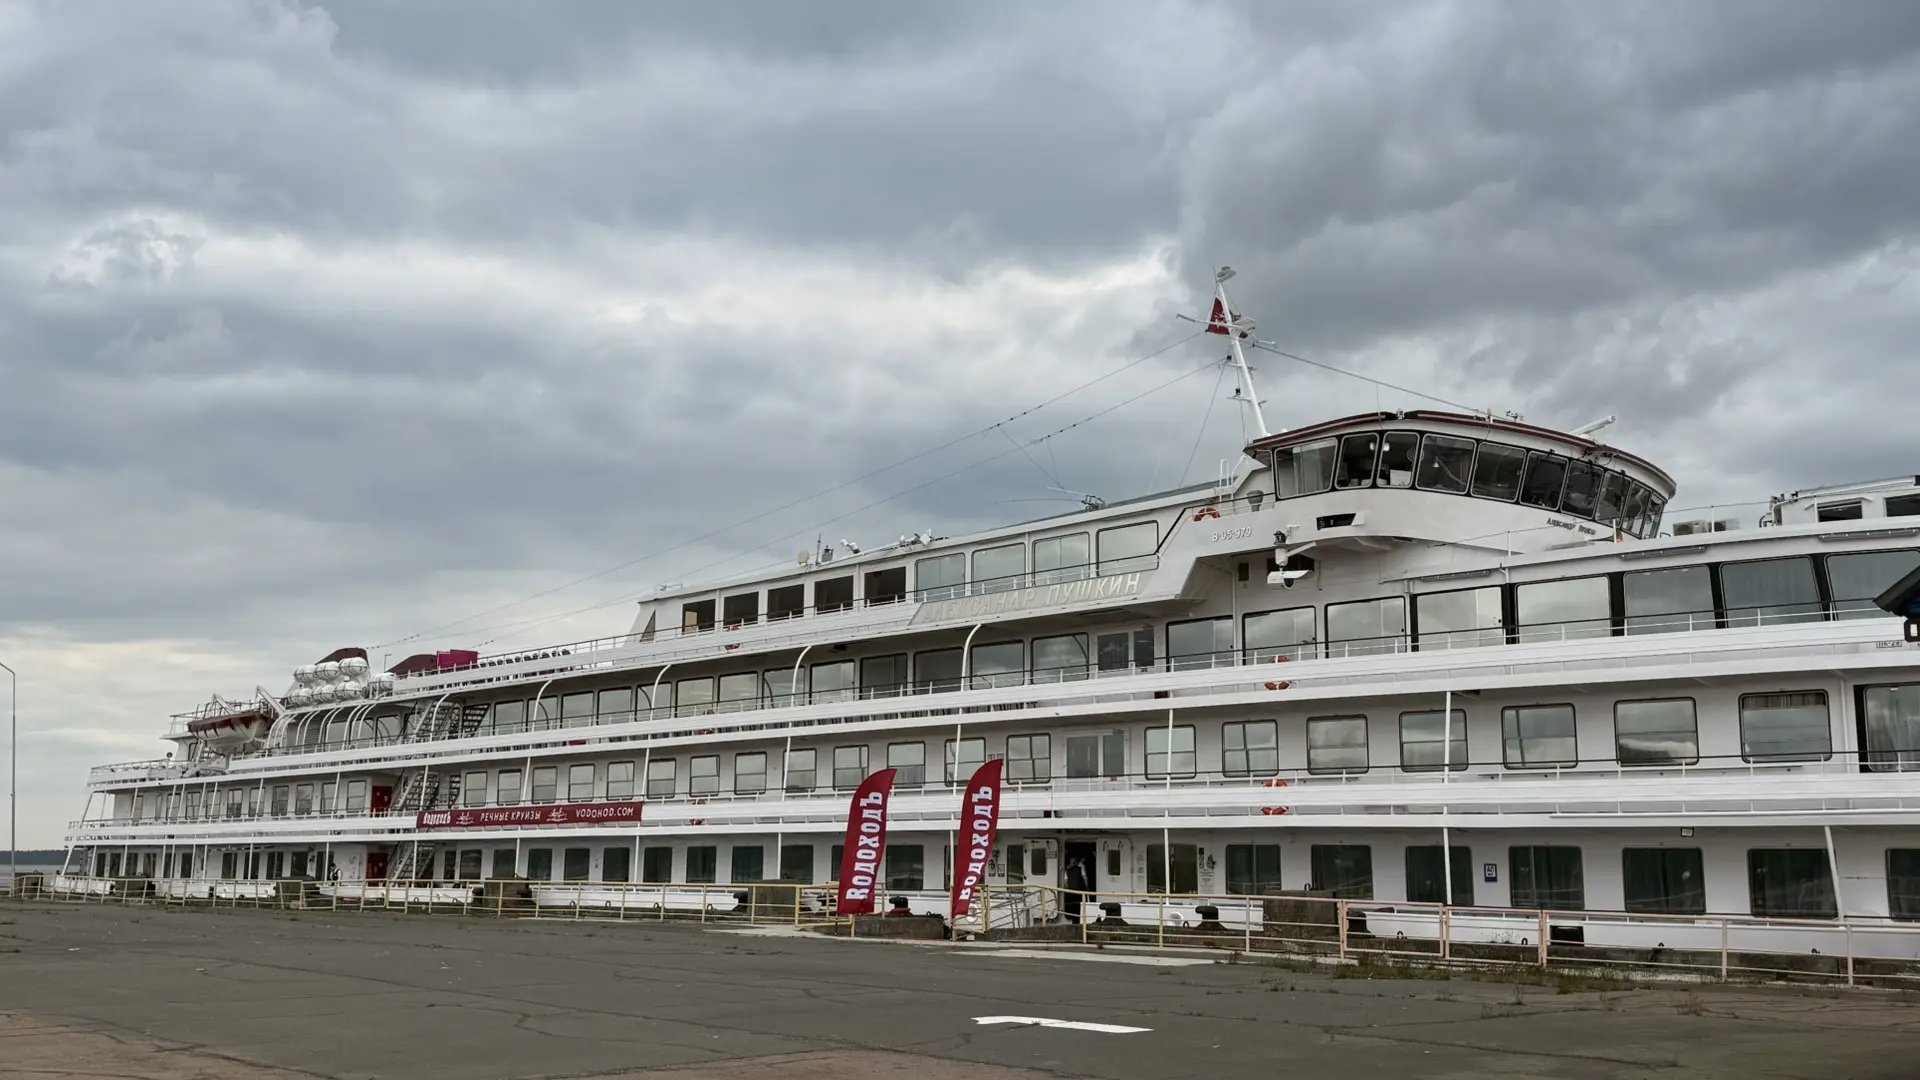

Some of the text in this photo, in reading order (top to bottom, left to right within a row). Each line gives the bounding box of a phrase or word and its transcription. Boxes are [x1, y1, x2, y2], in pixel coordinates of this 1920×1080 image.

[1047, 573, 1140, 604] ПУШКИН
[480, 811, 541, 822] РЕЧНЫЕ КРУИЗЫ
[575, 806, 634, 819] VODOHOD.COM
[845, 791, 883, 900] ВОДОХОДЪ
[958, 786, 993, 900] ВОДОХОДЪ
